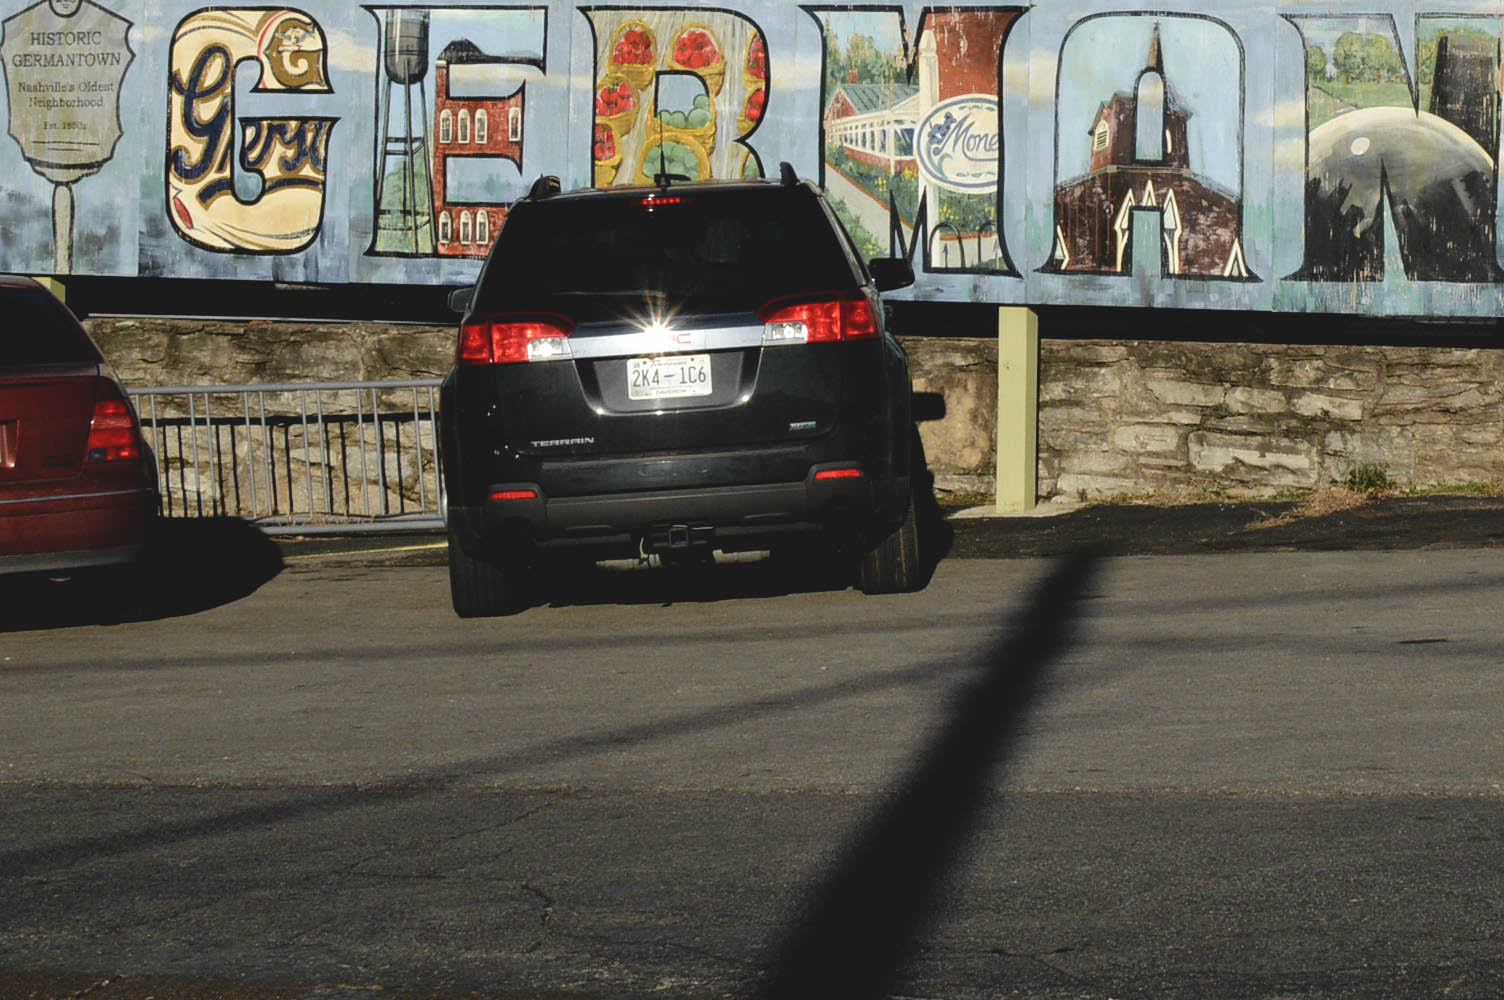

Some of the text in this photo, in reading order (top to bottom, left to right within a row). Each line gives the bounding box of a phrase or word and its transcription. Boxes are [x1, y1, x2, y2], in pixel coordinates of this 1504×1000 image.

[30, 31, 102, 46] HISTORIC
[12, 53, 121, 68] GERMANTOWN
[18, 81, 114, 93] Nashville's Oldest
[28, 96, 104, 111] Neighborhood
[530, 436, 594, 447] TERRAIN
